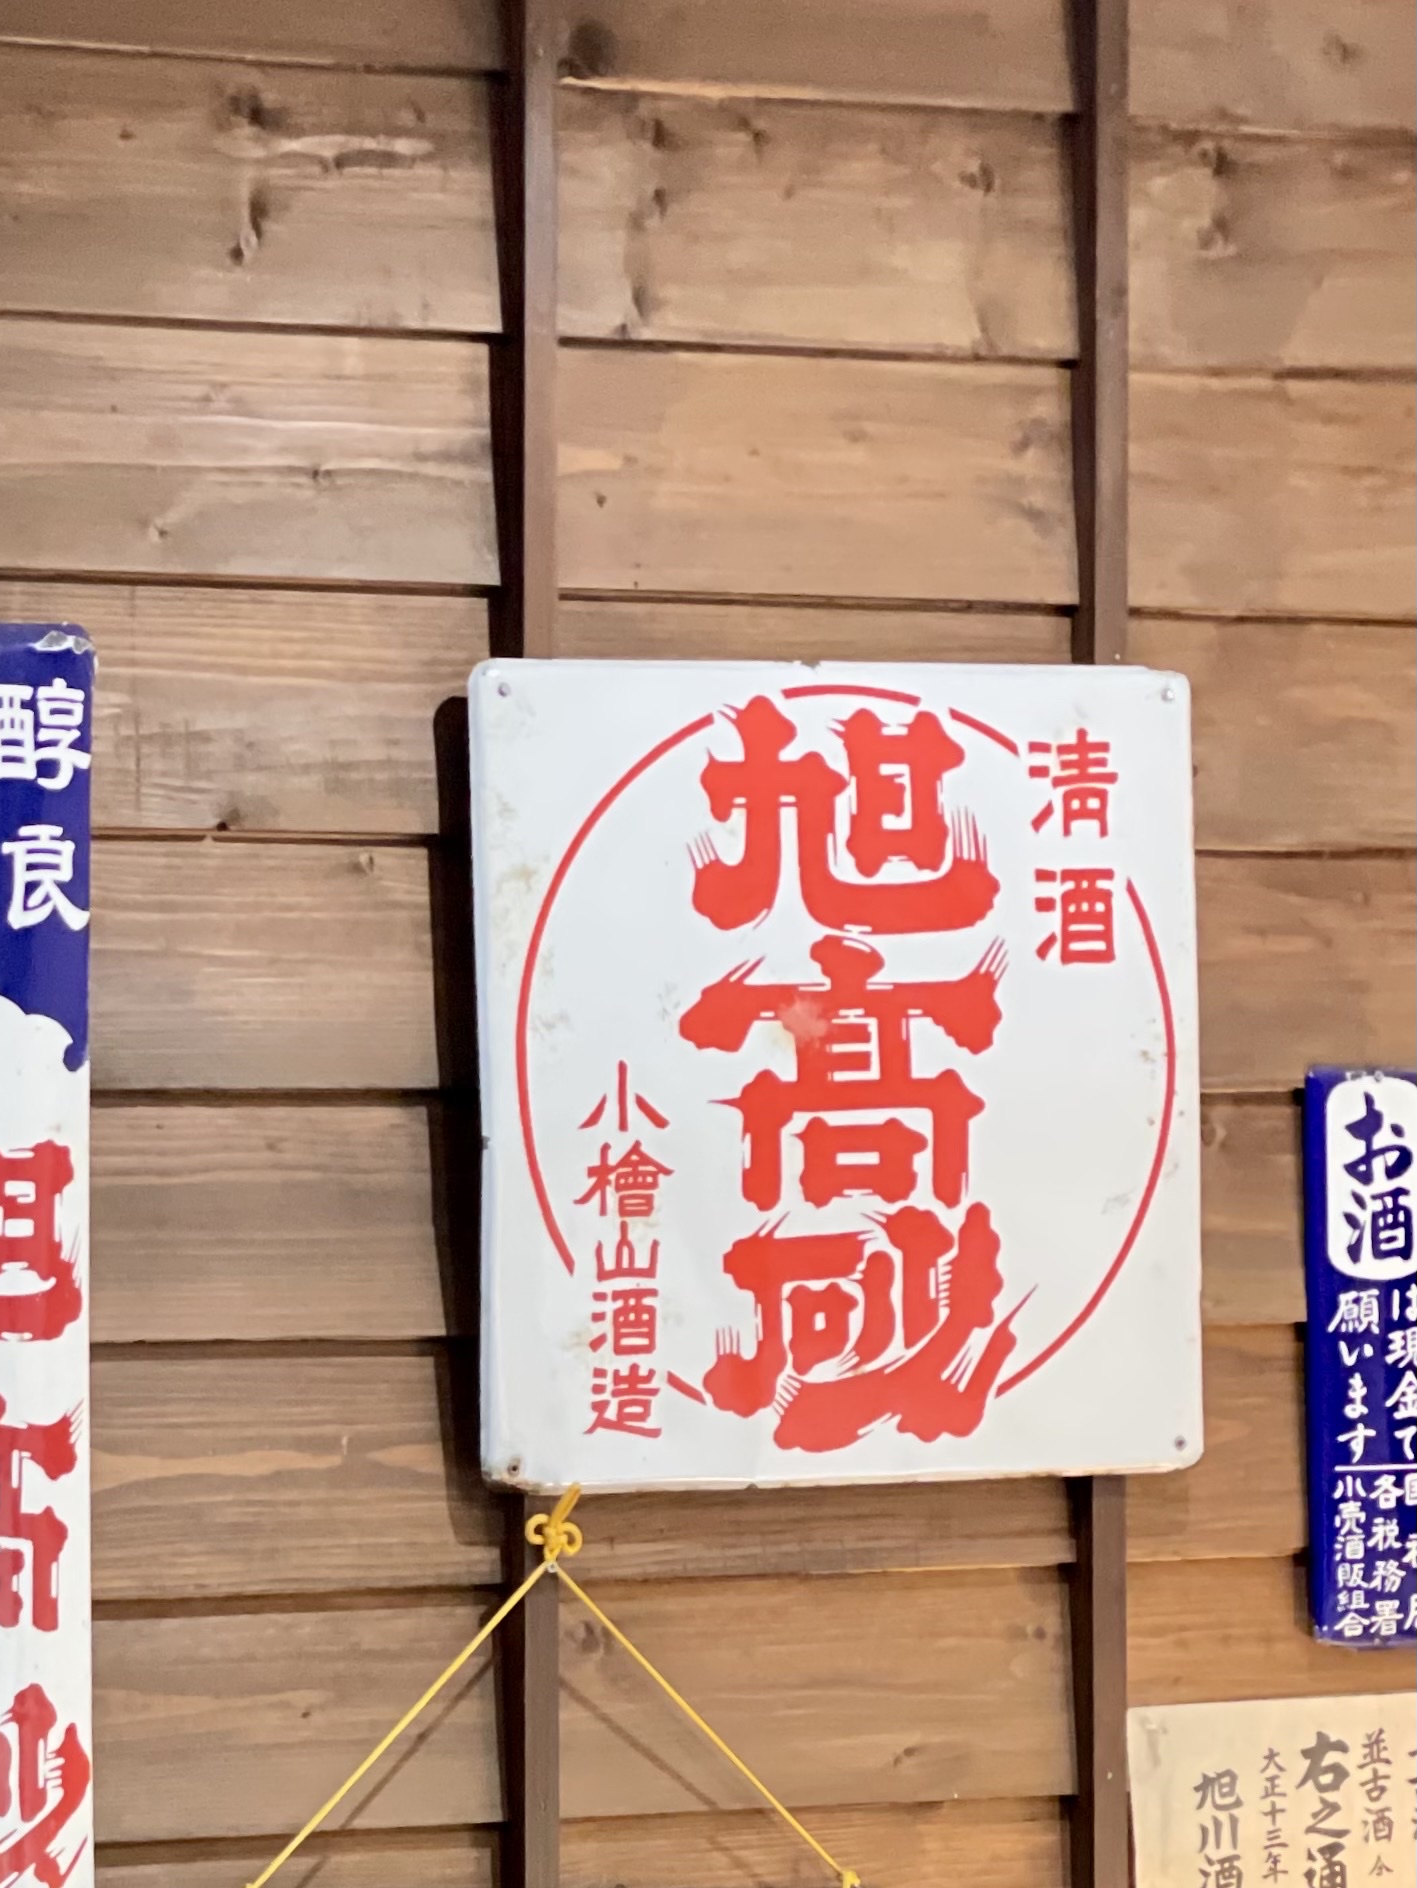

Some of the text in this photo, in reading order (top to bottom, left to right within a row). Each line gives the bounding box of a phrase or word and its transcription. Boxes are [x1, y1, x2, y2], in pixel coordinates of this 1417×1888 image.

[1027, 727, 1120, 966] 清酒
[573, 1059, 675, 1440] 小檜山酒造
[1343, 1091, 1413, 1265] お酒
[1327, 1288, 1380, 1464] 願います
[1367, 1474, 1406, 1637] 各税務署
